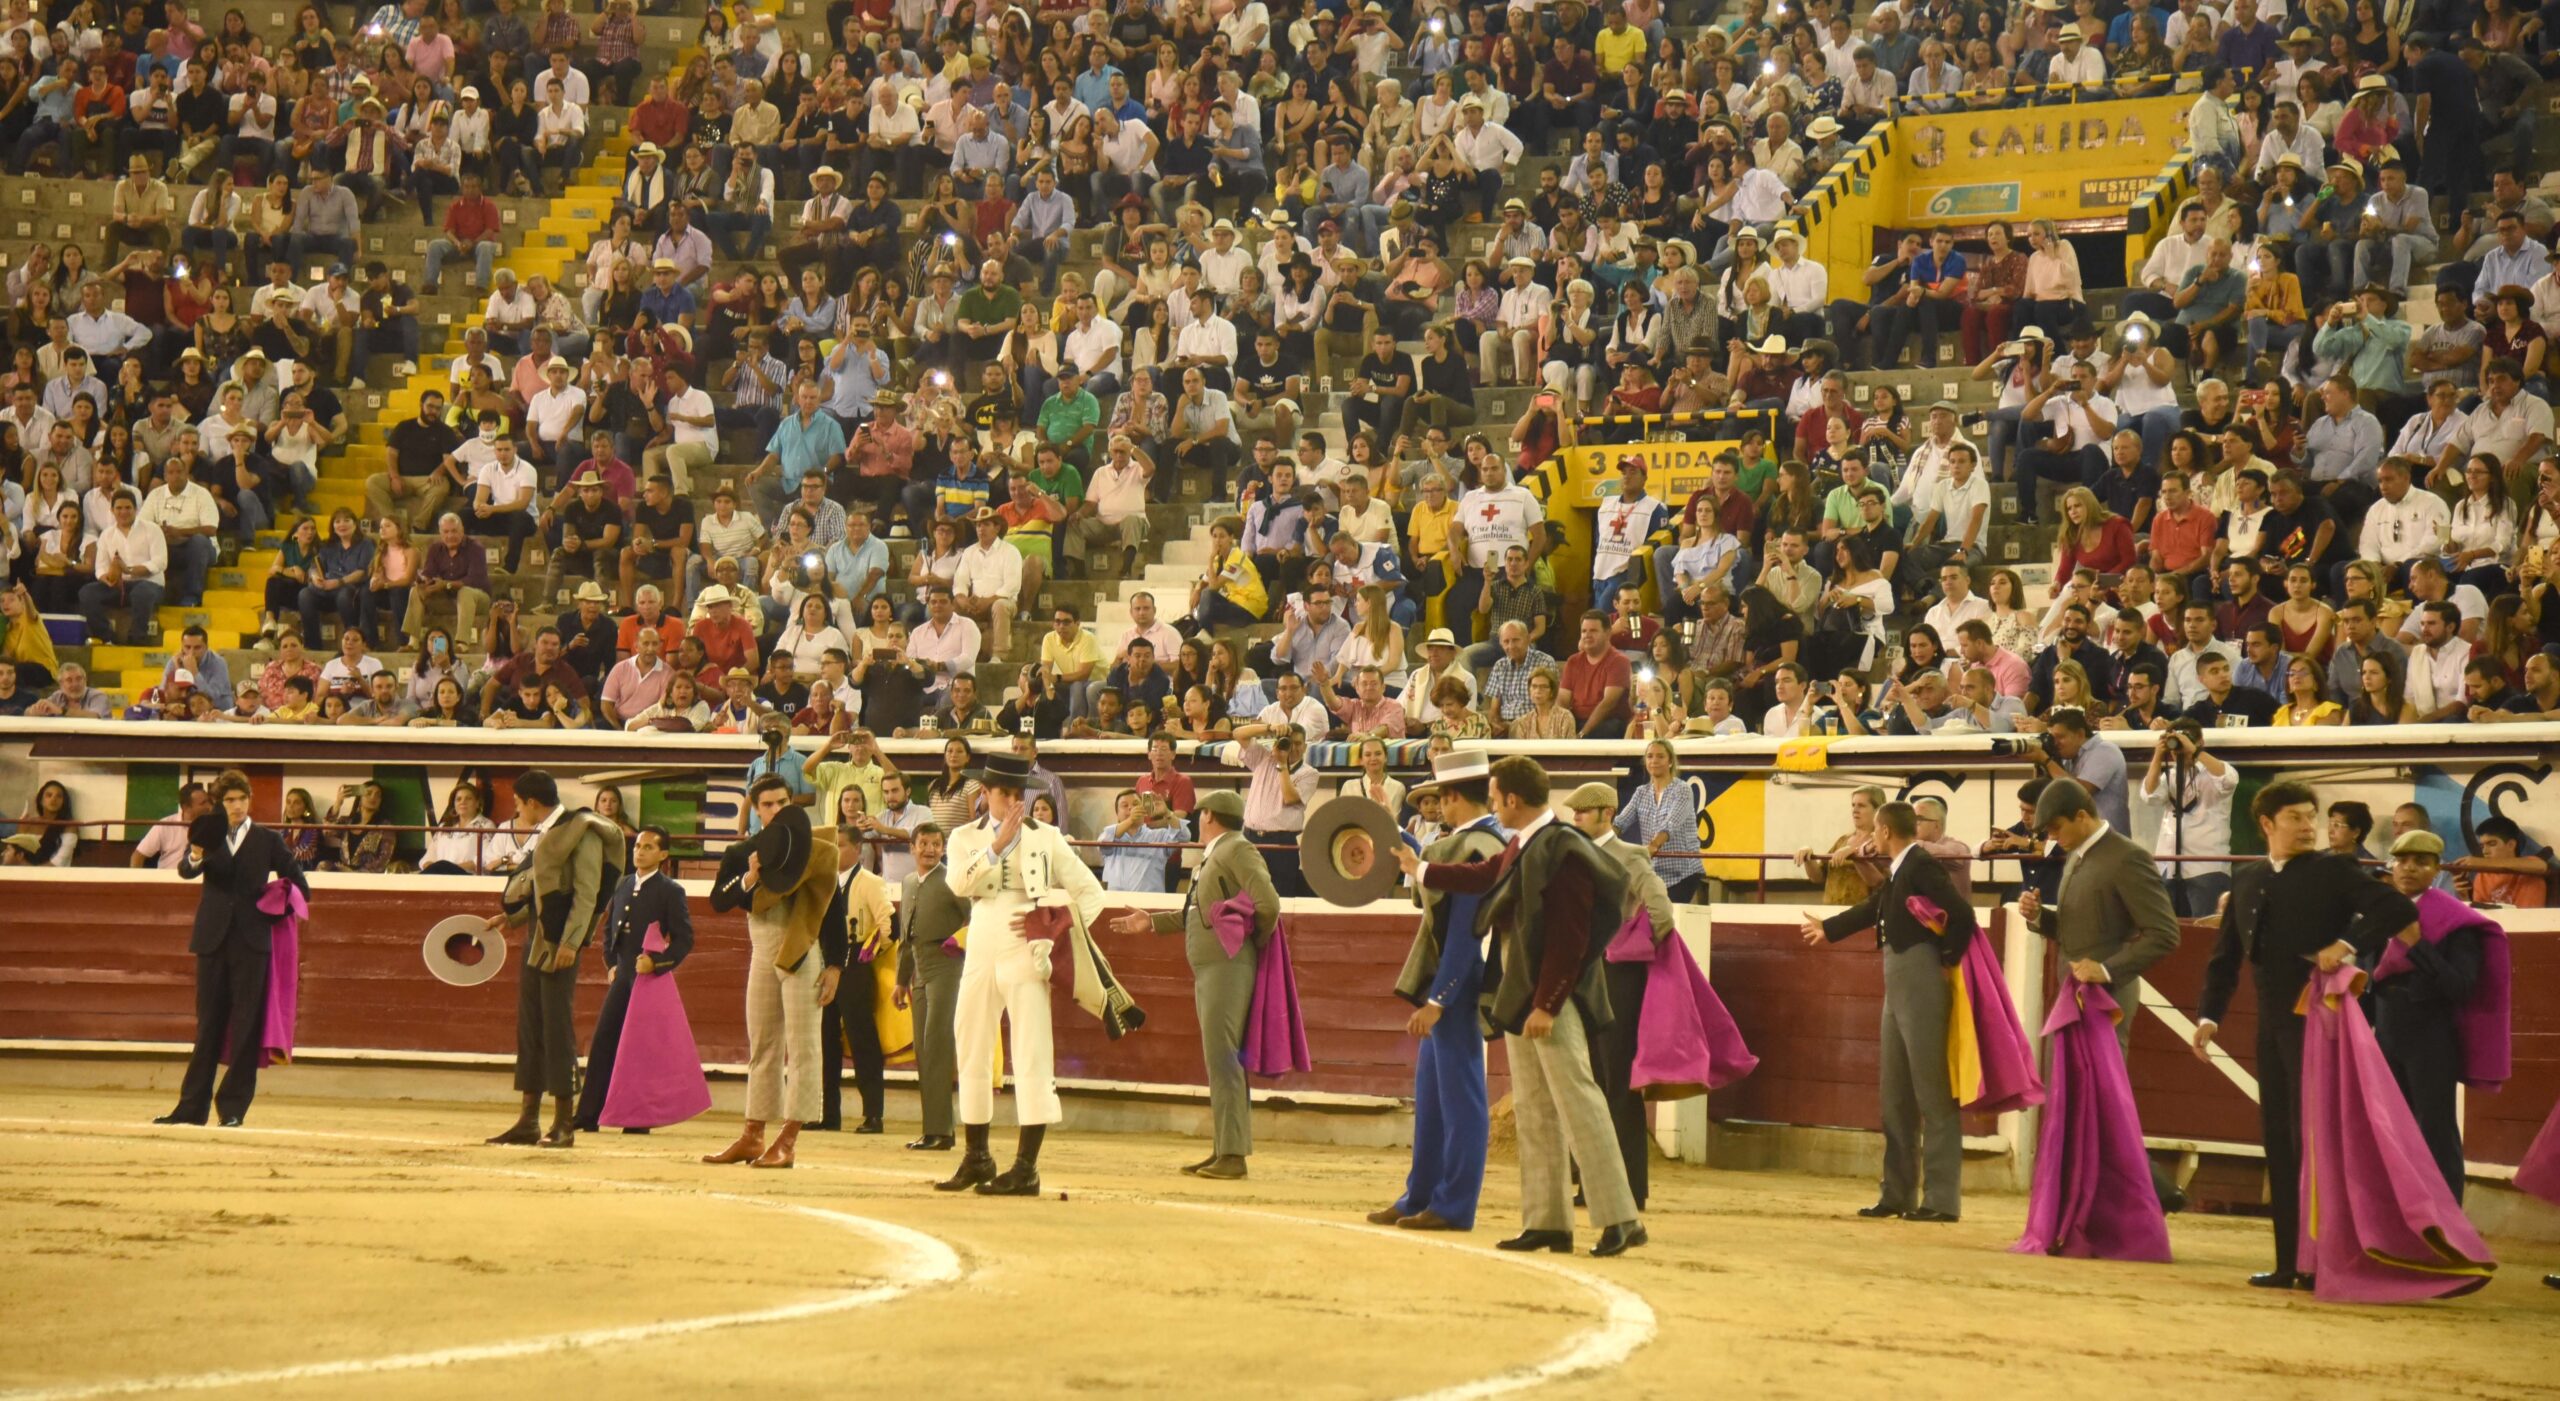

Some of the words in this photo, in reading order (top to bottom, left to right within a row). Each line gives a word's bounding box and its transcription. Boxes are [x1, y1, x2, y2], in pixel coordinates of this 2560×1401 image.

[1911, 125, 1946, 168] 3
[1968, 112, 2147, 160] SALIDA
[2107, 190, 2141, 204] UNI
[1588, 451, 1606, 475] 3
[1618, 451, 1712, 472] LIDA
[1491, 523, 1509, 533] Roja
